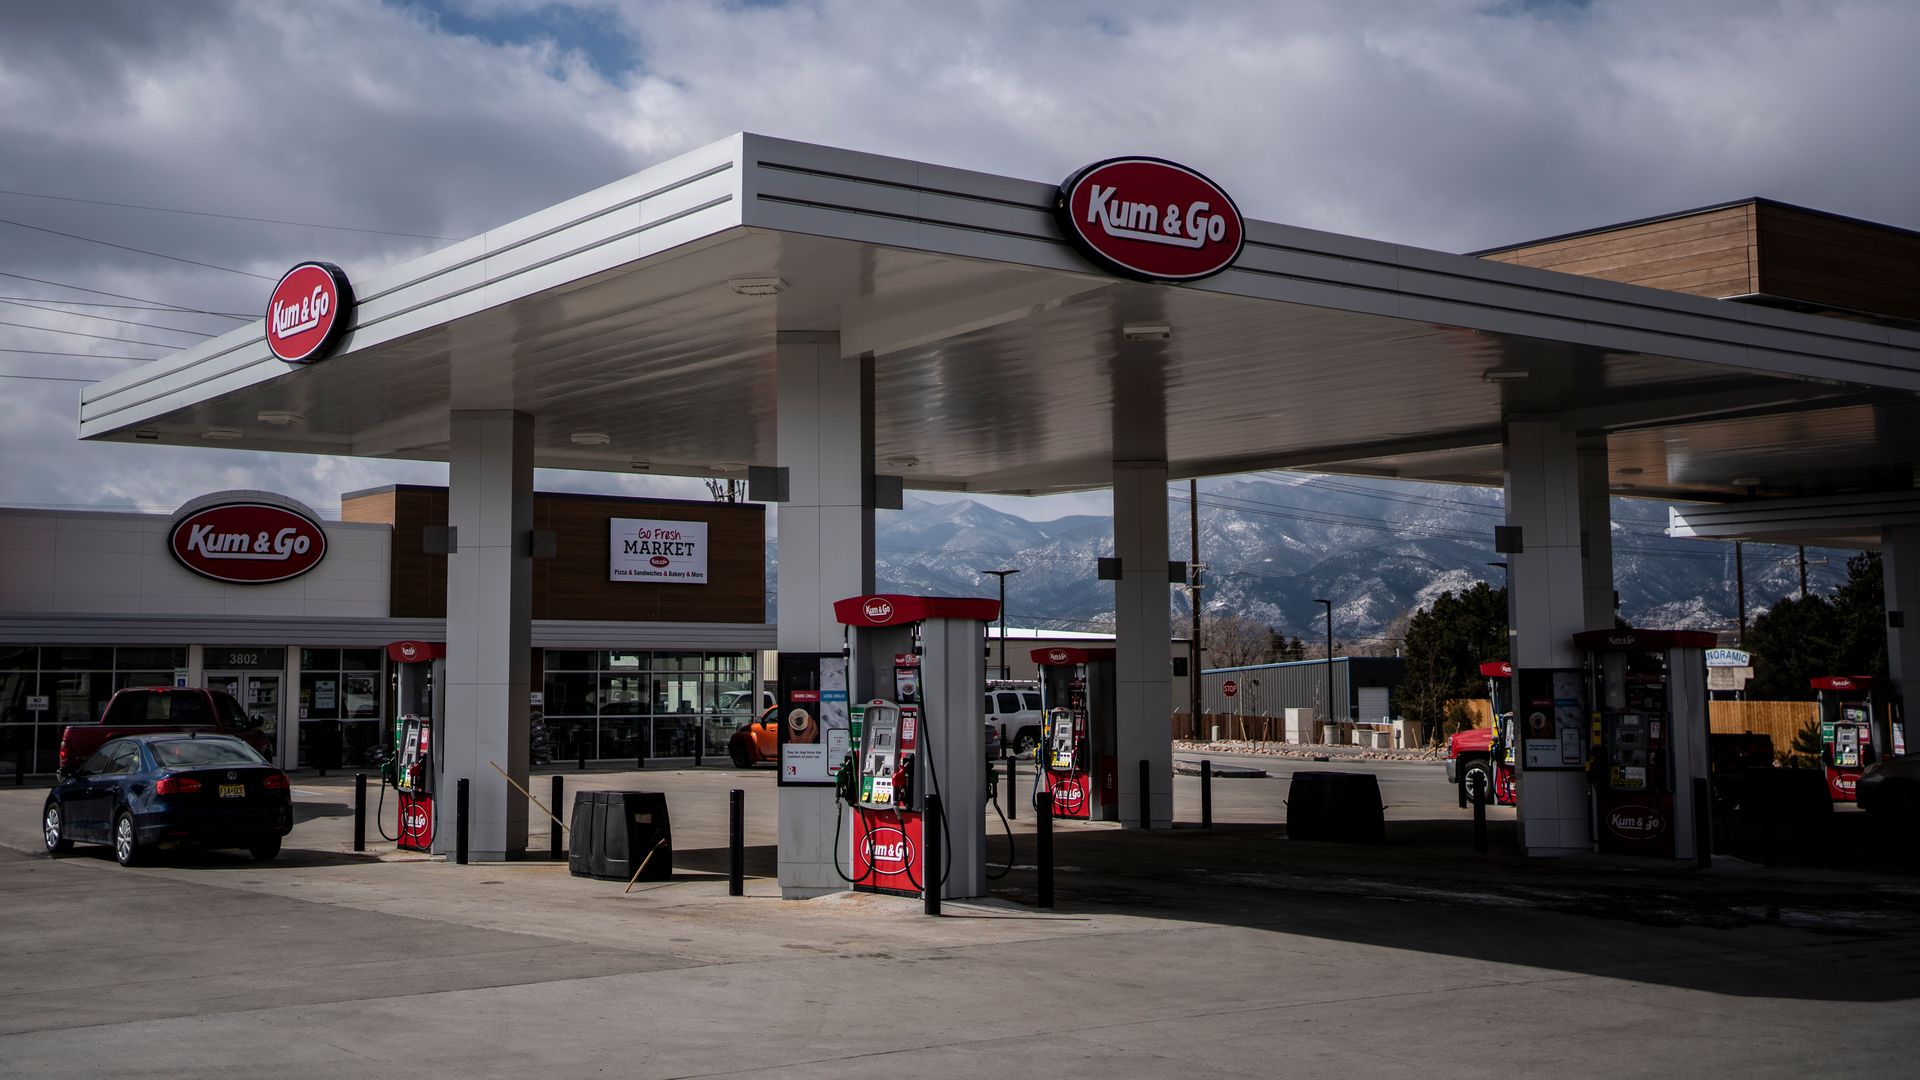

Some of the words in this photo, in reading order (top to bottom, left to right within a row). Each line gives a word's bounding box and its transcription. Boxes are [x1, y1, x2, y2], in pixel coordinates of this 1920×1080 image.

[1087, 184, 1159, 236] Kum
[1163, 204, 1182, 235] &
[1186, 201, 1226, 248] Go
[272, 300, 300, 338] Kum
[301, 296, 310, 322] &
[311, 285, 329, 327] Go
[638, 528, 652, 540] Go
[654, 528, 682, 541] Fresh
[187, 524, 250, 558] Kum
[253, 531, 271, 553] &
[274, 528, 310, 560] Go
[624, 540, 695, 556] MARKET
[634, 569, 662, 577] Sandwiches
[669, 570, 686, 579] Bakery
[866, 605, 878, 616] Kum
[882, 604, 891, 616] Go
[230, 653, 258, 665] 3802
[1707, 650, 1748, 663] NORAMIC
